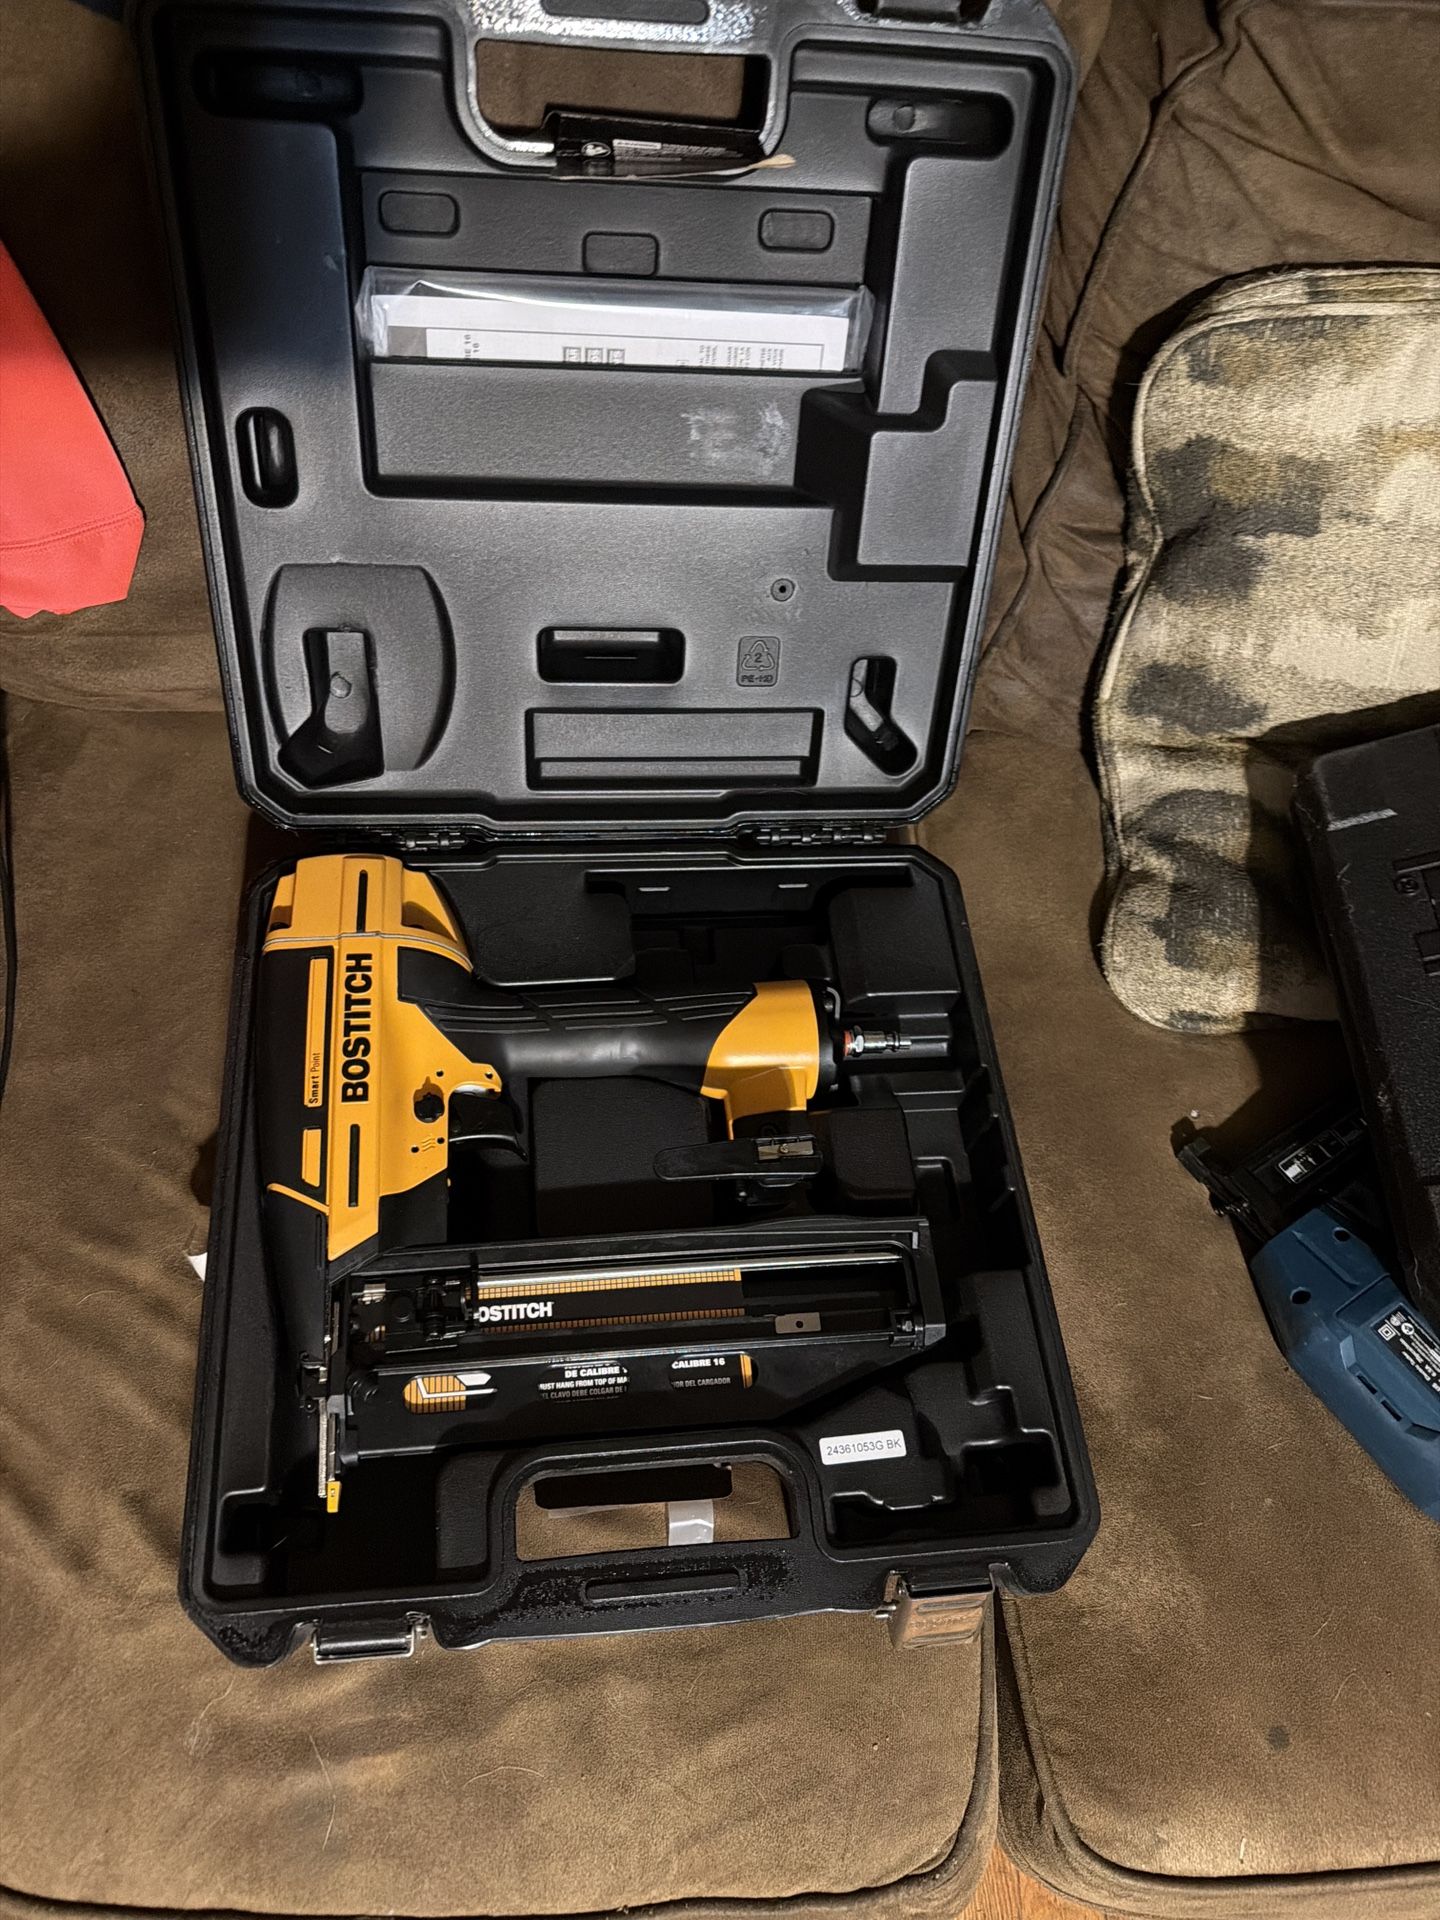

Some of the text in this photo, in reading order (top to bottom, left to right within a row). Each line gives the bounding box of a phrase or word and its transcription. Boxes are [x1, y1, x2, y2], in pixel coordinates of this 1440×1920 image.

[754, 652, 762, 663] 2
[341, 953, 373, 1103] BOSTITCH
[309, 1052, 320, 1104] Smart Point
[671, 1357, 726, 1370] CALIBRE 16
[564, 1369, 578, 1379] DE
[579, 1366, 620, 1377] CALIBRE
[556, 1380, 575, 1389] HANG
[575, 1379, 594, 1387] FROM
[607, 1377, 616, 1385] OF
[616, 1376, 630, 1384] MA
[827, 1438, 902, 1456] 24361053G BK
